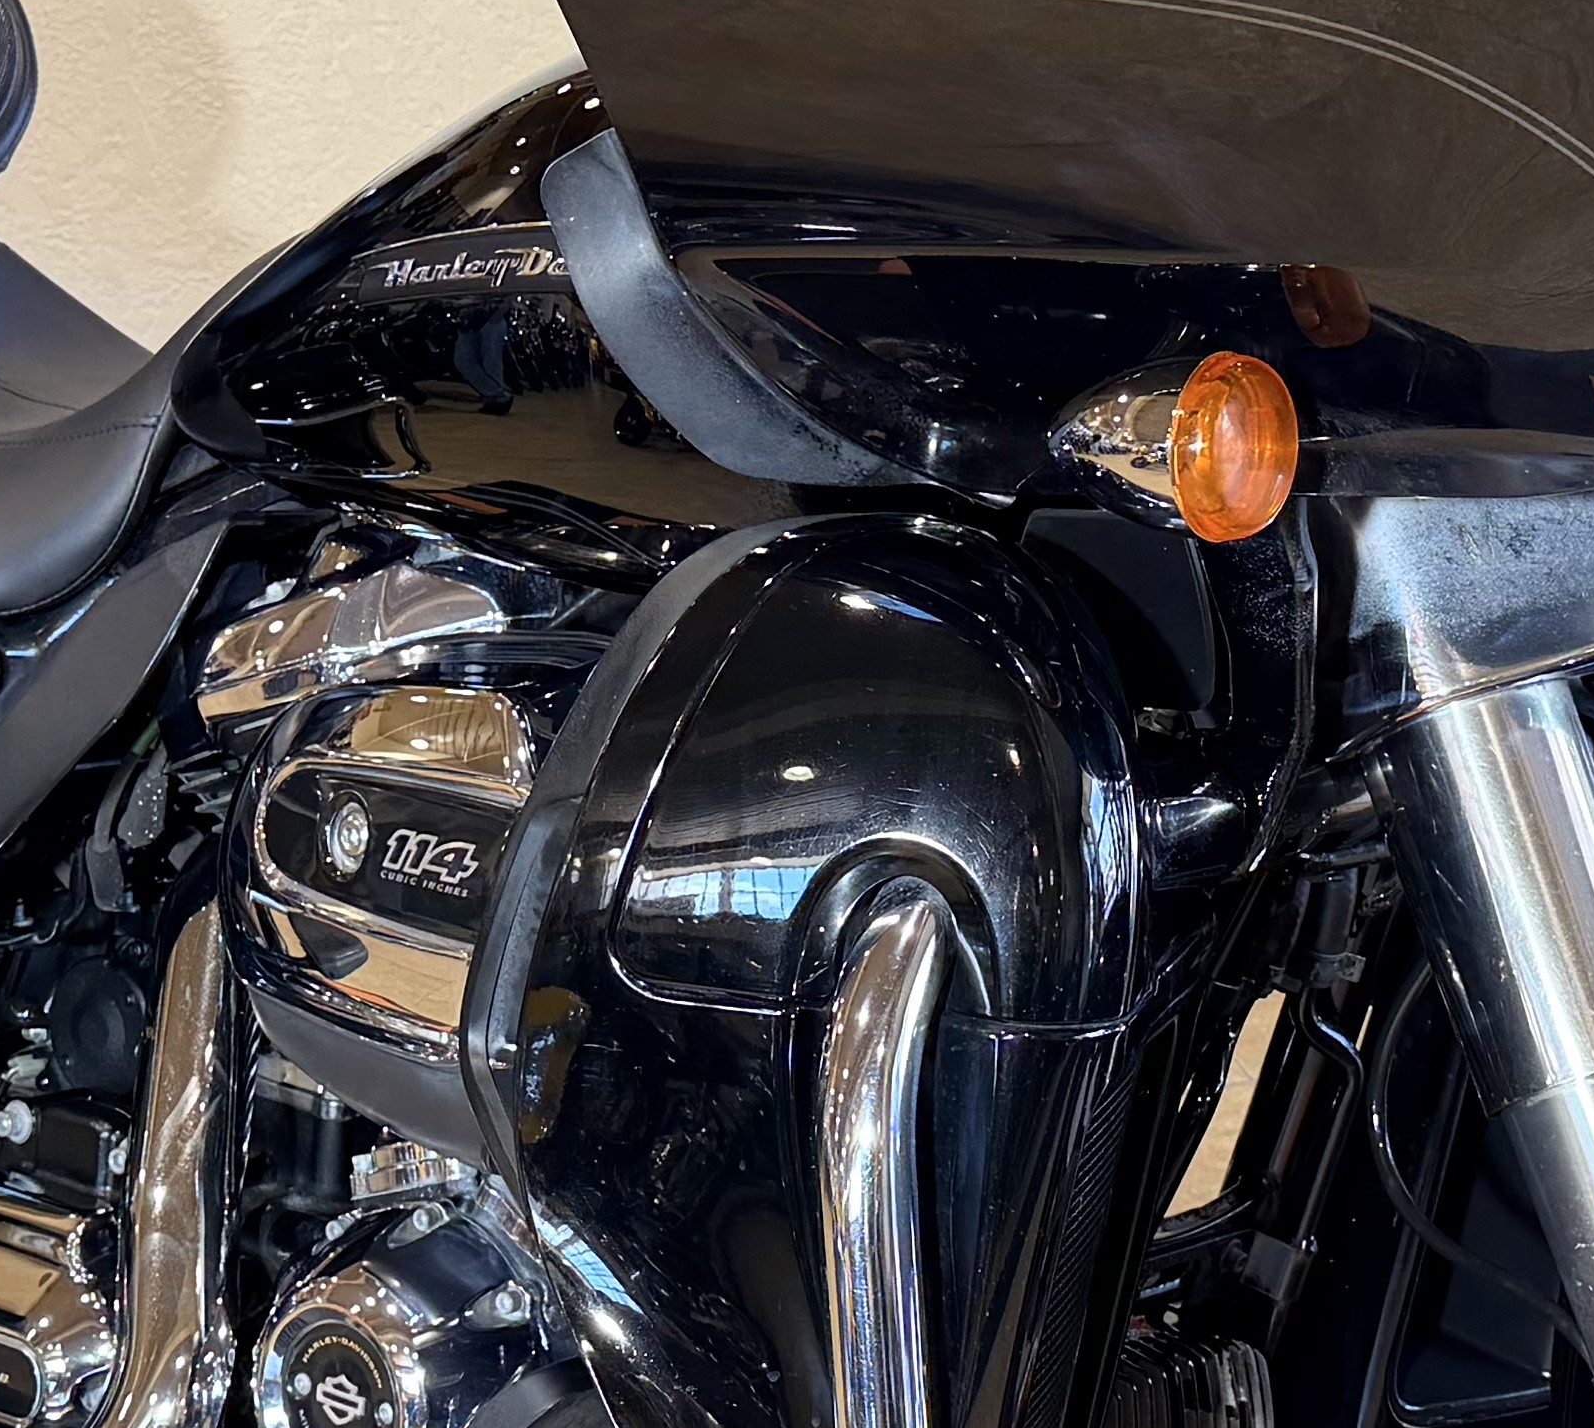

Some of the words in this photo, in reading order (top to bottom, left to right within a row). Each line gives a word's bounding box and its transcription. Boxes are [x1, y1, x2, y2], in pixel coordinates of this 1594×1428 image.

[382, 828, 480, 884] 114
[380, 869, 419, 886] CUBIC
[422, 879, 469, 898] INCHES
